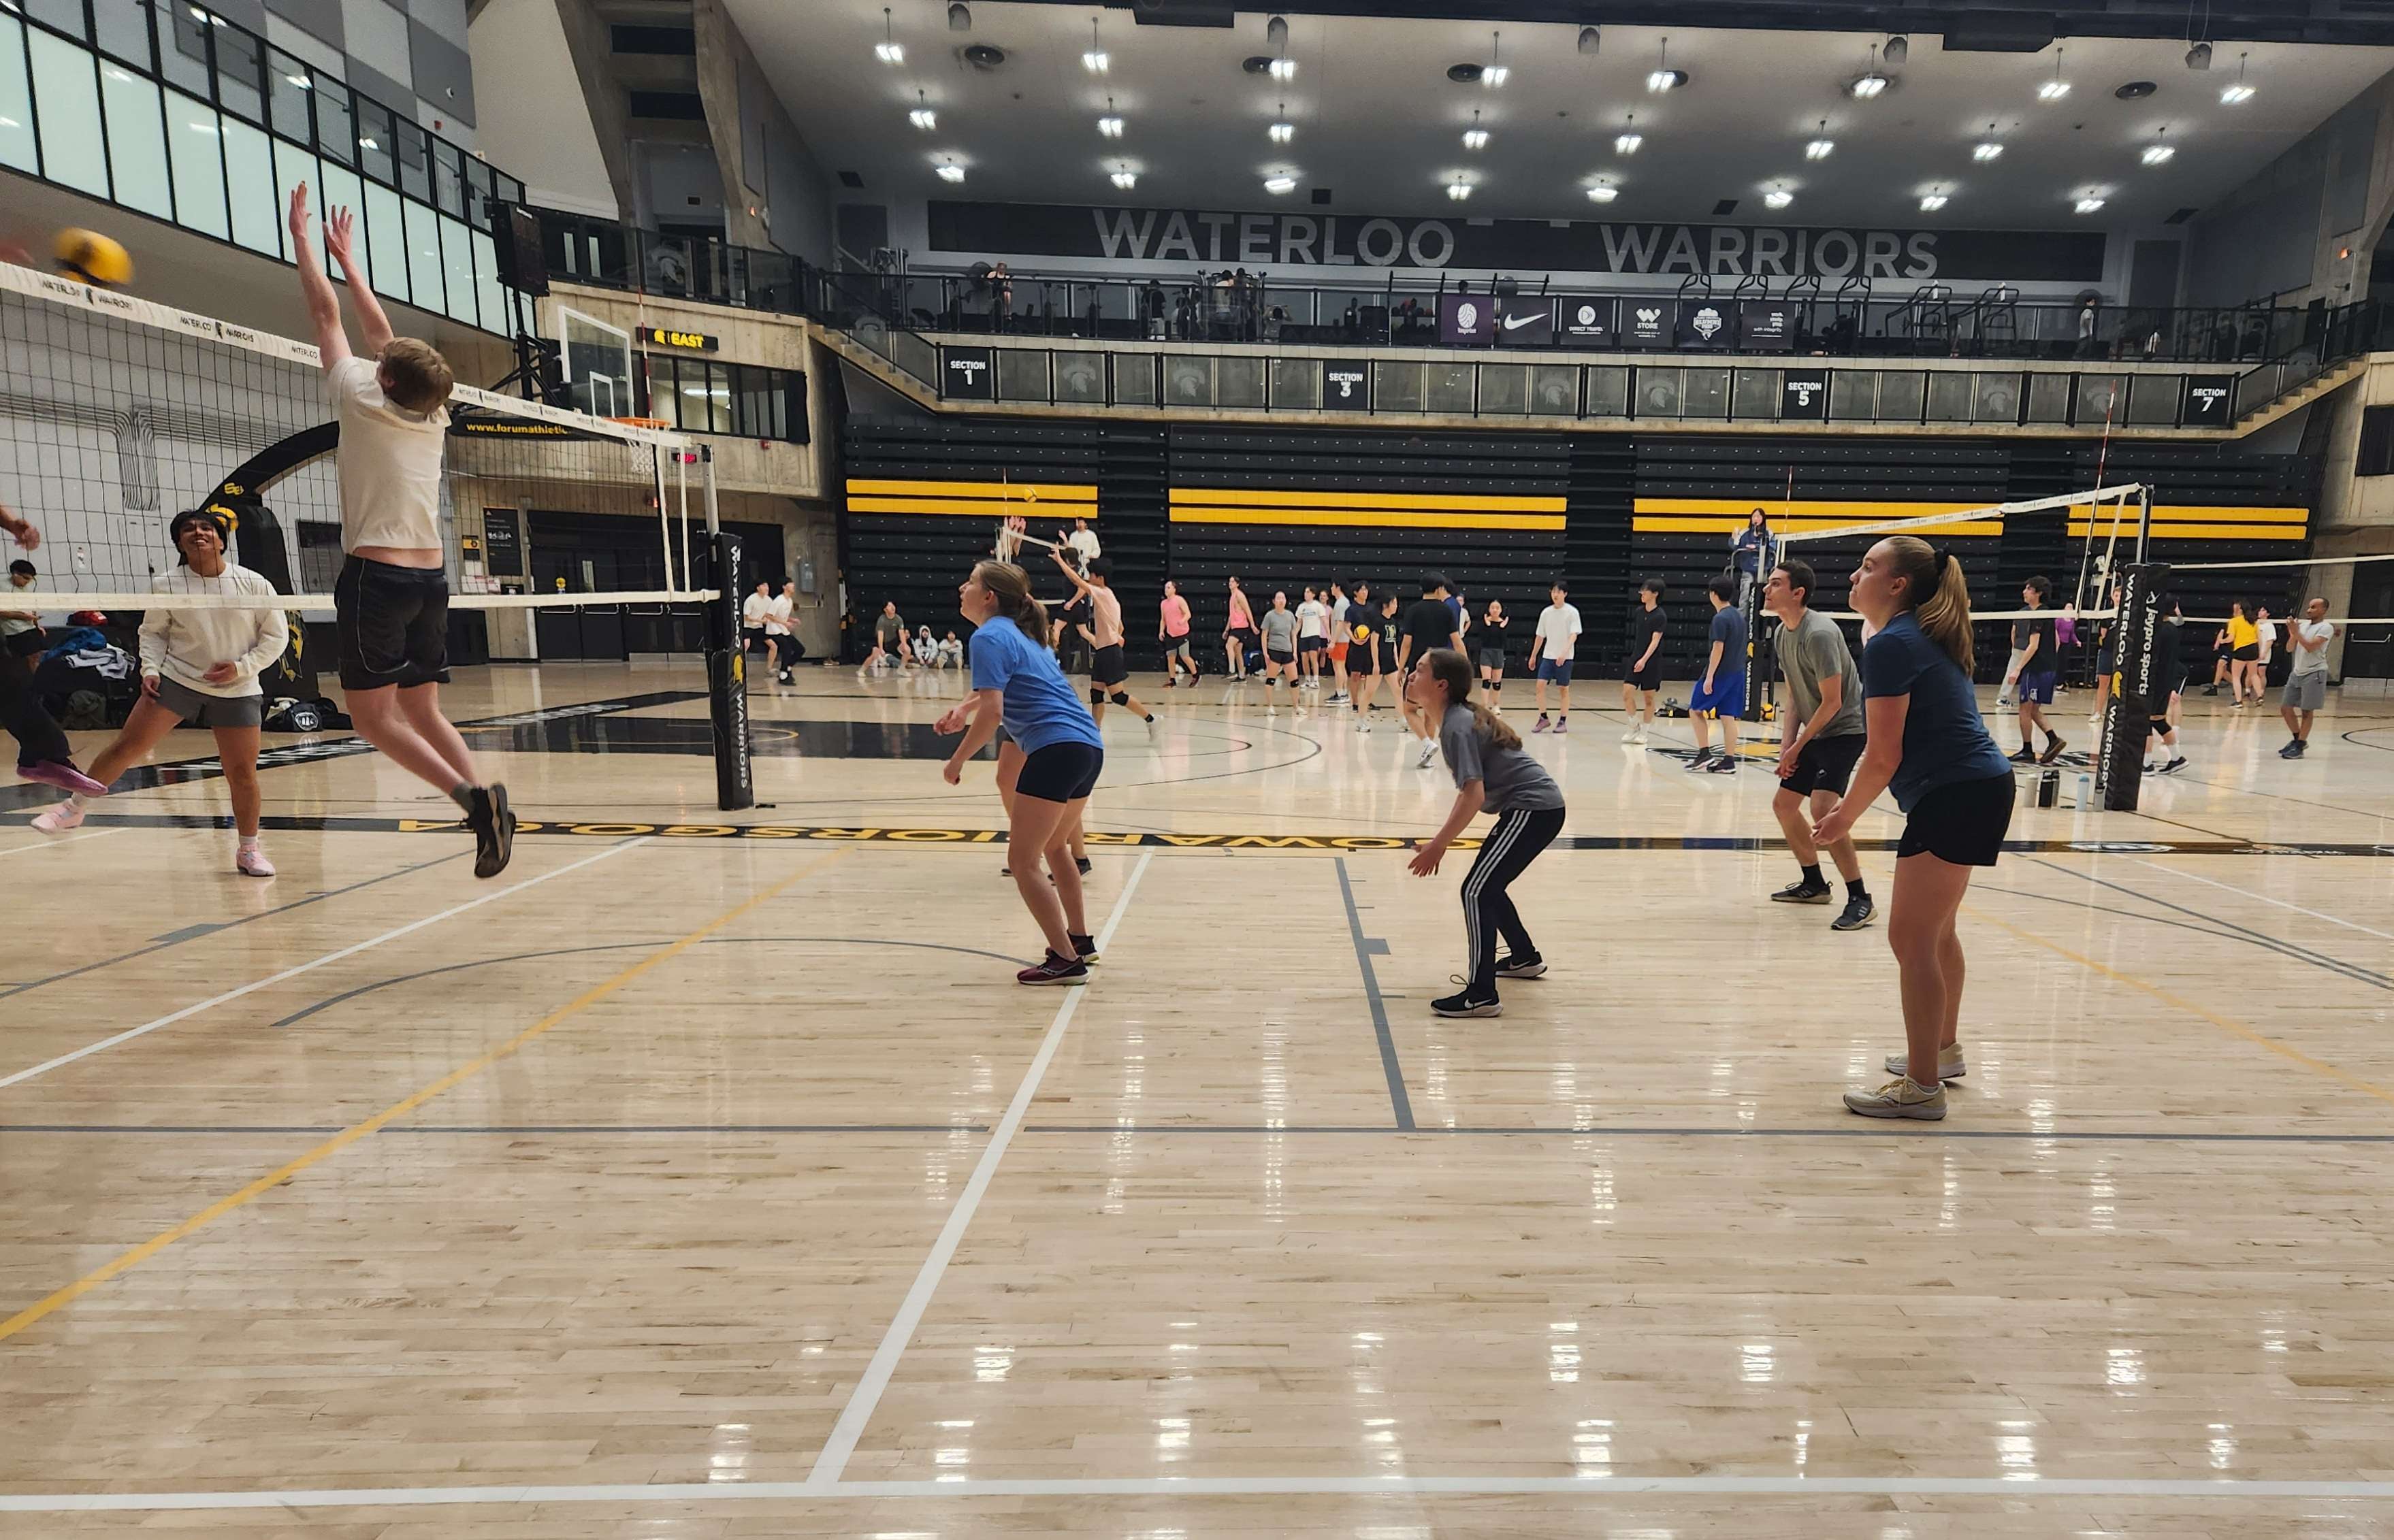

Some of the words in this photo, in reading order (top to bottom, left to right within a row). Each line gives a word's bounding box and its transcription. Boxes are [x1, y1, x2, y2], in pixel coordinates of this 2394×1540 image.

[1094, 208, 1455, 267] WATERLOO
[1600, 225, 1939, 279] WARRIORS
[671, 332, 704, 348] EAST
[950, 361, 986, 370] SECTION
[964, 370, 973, 385] 1
[1329, 372, 1363, 382] SECTION
[1340, 381, 1351, 397] 3
[1788, 382, 1822, 391] SECTION
[2192, 388, 2227, 397] SECTION
[1798, 391, 1809, 406] 5
[2201, 397, 2214, 412] 7
[2116, 573, 2136, 666] WATERLOO
[2144, 606, 2158, 652] Jaypro
[2139, 653, 2151, 695] sports
[736, 693, 748, 789] WARRIORS
